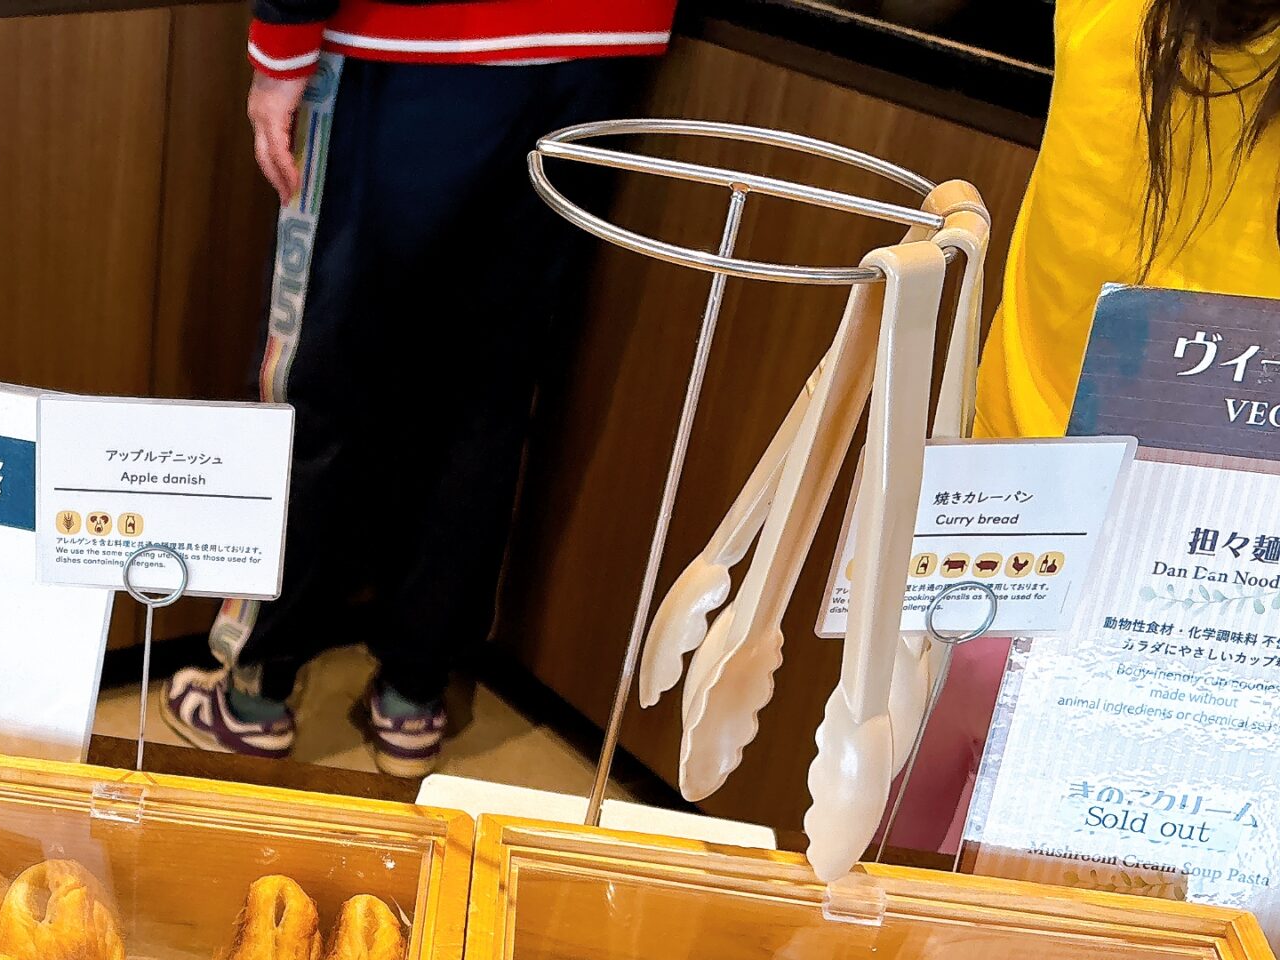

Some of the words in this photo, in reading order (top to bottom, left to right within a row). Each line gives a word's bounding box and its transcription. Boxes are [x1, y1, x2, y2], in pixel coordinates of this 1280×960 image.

[105, 449, 224, 465] アップルデニッシュ
[120, 471, 159, 485] Apple
[162, 472, 207, 486] danish
[932, 491, 1034, 506] 焼きカレーパン
[935, 513, 973, 527] Curry
[977, 513, 1019, 525] bread
[55, 546, 69, 554] We
[86, 547, 100, 556] the
[202, 553, 226, 562] those
[227, 555, 247, 564] used
[249, 556, 262, 564] for
[55, 556, 81, 564] dishes
[83, 558, 124, 568] containing
[1152, 561, 1188, 579] Dan
[1192, 565, 1228, 583] Dan
[1011, 592, 1032, 601] used
[1033, 592, 1047, 601] for
[1103, 616, 1258, 646] 動物性食材・化学調味料
[1122, 638, 1280, 667] カラダにやさしいカップ
[1149, 688, 1186, 701] made
[1189, 692, 1239, 708] without
[1057, 696, 1100, 710] animal
[1102, 701, 1173, 720] ingredients
[1176, 710, 1192, 720] or
[1193, 711, 1249, 729] chemical
[1085, 806, 1149, 834] Sold
[1160, 820, 1211, 843] out
[1122, 854, 1177, 874] Cream
[1181, 861, 1222, 882] Soup
[1227, 867, 1270, 887] Pasta
